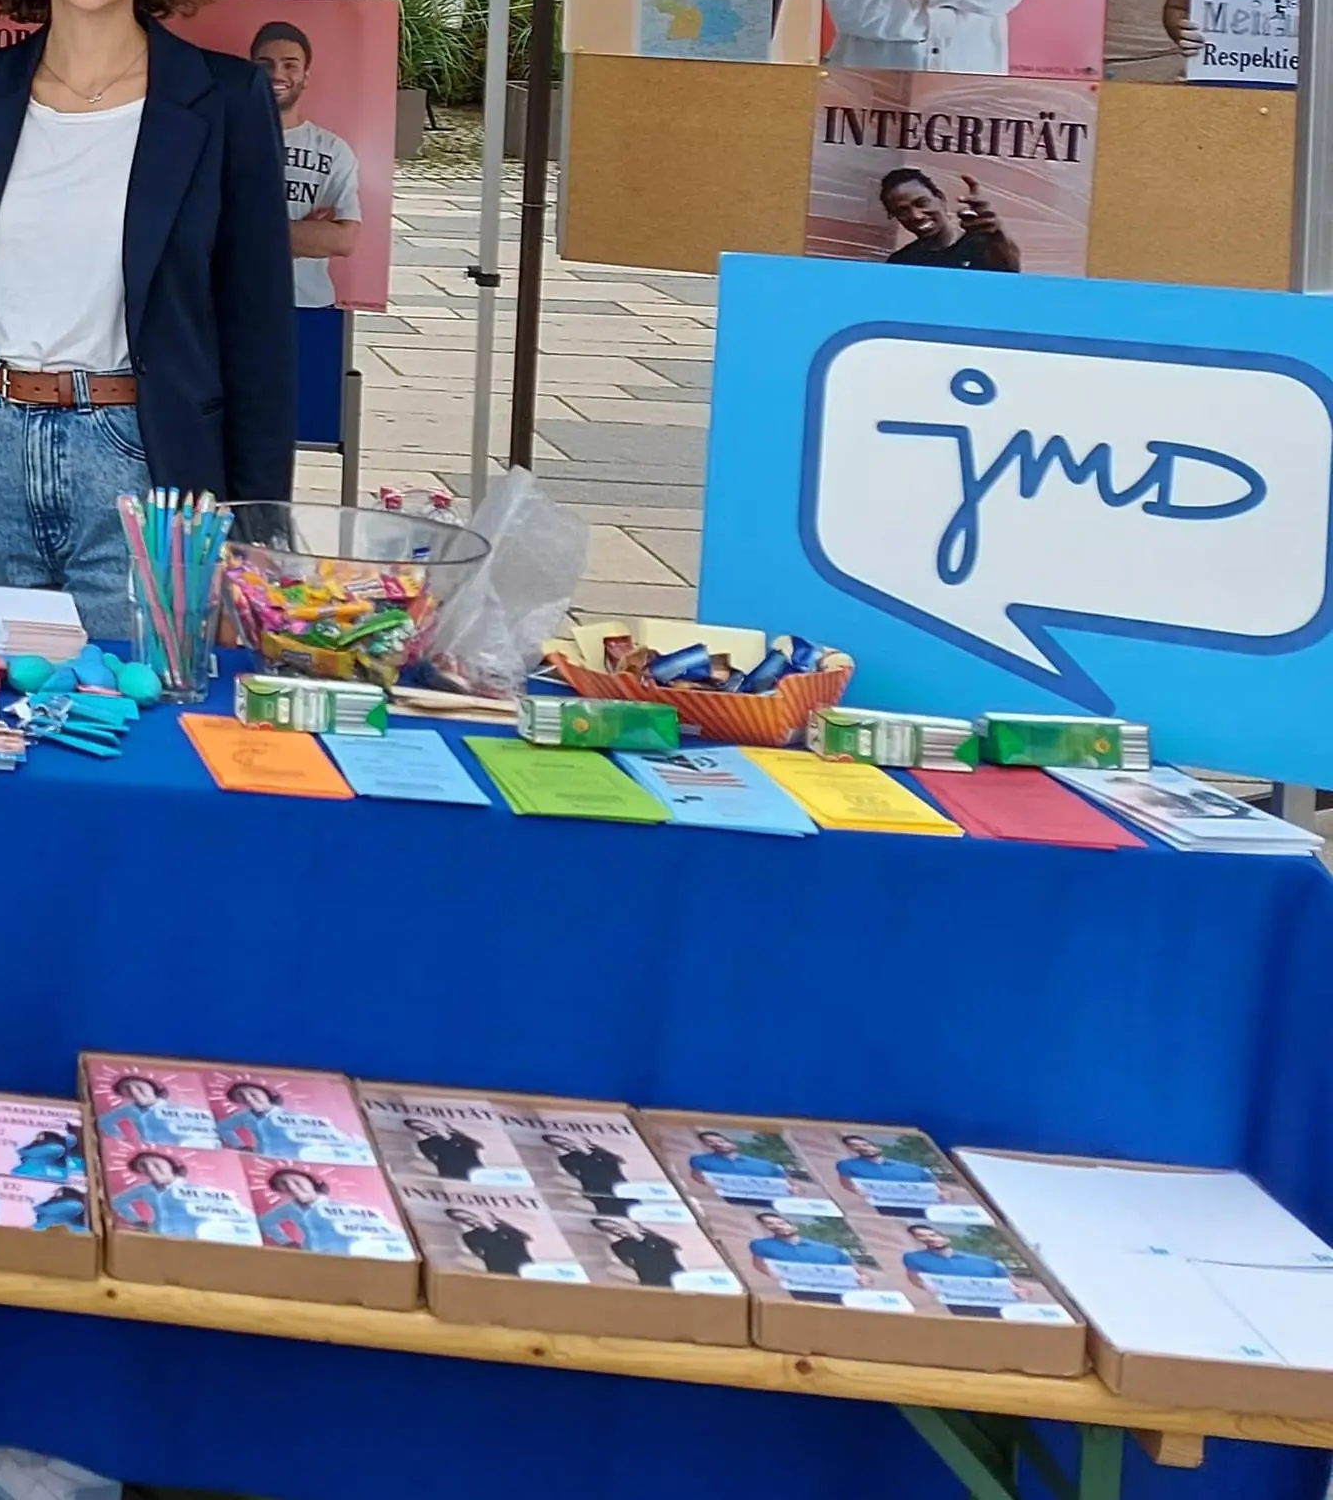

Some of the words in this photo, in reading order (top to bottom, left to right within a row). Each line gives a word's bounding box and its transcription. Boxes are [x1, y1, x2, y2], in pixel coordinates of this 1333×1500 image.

[824, 106, 1088, 164] INTEGRITÄT
[365, 1100, 493, 1121] INTEGRITÄT
[501, 1115, 632, 1135] INTEGRITÄT
[402, 1186, 540, 1209] INTEGRITÄT
